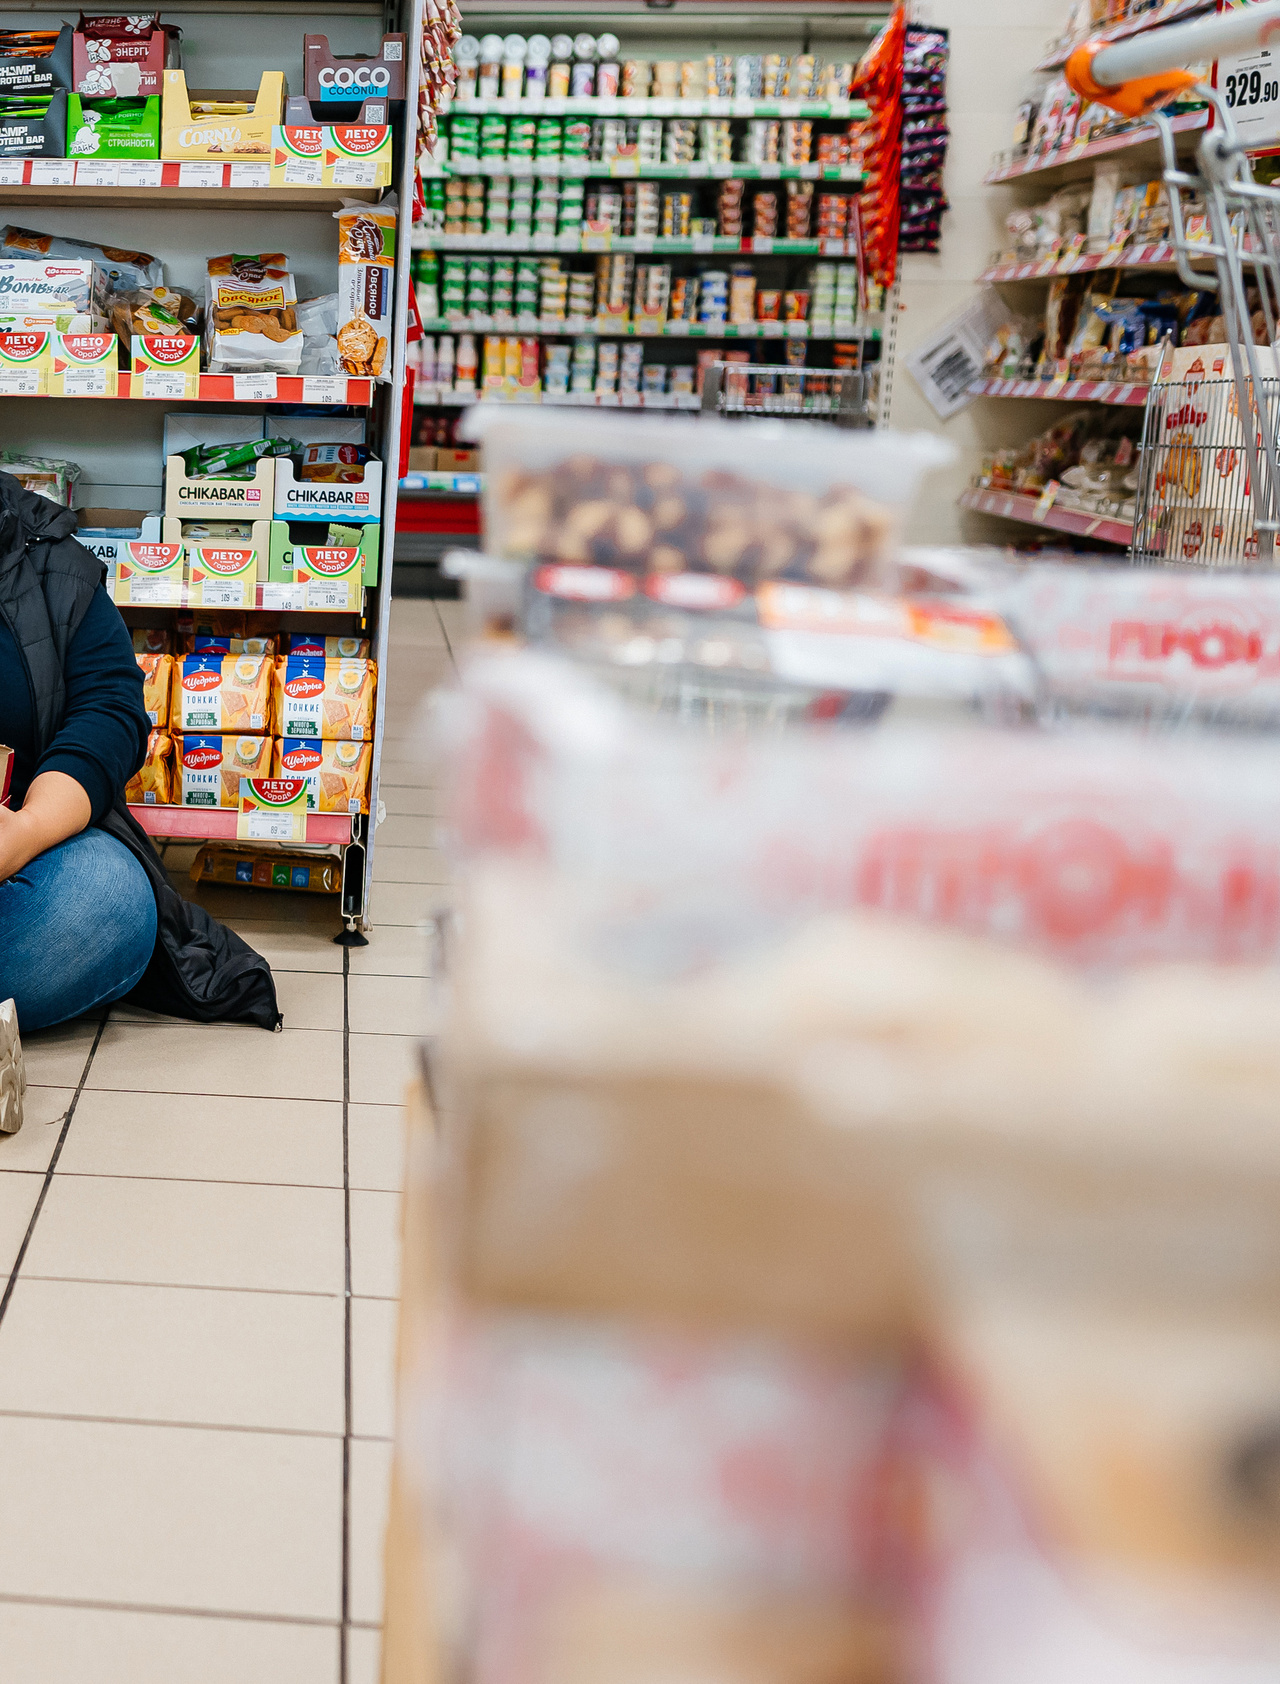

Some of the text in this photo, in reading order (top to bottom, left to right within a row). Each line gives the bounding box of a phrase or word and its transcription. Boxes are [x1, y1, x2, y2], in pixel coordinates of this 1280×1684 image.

[34, 73, 52, 82] BAR
[318, 66, 390, 88] COCO
[329, 86, 379, 96] COCONUT
[1226, 70, 1278, 108] 329.90
[179, 126, 235, 148] CORNY
[344, 129, 377, 138] ЛЕТО
[26, 136, 44, 144] BAR
[108, 139, 154, 148] СТРОЙНОСТИ
[72, 144, 95, 154] ЛАЙК
[347, 140, 375, 151] городе
[222, 294, 280, 304] ОВСЯНОЕ
[4, 336, 36, 344] ЛЕТО
[72, 338, 103, 346] ЛЕТО
[153, 338, 186, 348] ЛЕТО
[8, 346, 35, 360] городе
[74, 348, 102, 359] городе
[155, 350, 184, 361] городе
[178, 486, 245, 500] CHIKABAR
[286, 490, 354, 504] CHIKABAR
[138, 546, 170, 555] ЛЕТО
[316, 550, 348, 560] ЛЕТО
[211, 552, 242, 560] ЛЕТО
[142, 557, 168, 568] городе
[214, 562, 240, 572] городе
[318, 562, 346, 572] городе
[184, 676, 220, 689] Щедрые
[286, 682, 322, 696] Щедрые
[187, 696, 218, 704] ТОНКИЕ
[288, 703, 320, 713] ТОНКИЕ
[184, 751, 221, 768] Щедрые
[284, 754, 320, 768] Щедрые
[186, 774, 218, 784] ТОНКИЕ
[262, 780, 294, 790] ЛЕТО
[264, 791, 292, 802] городе
